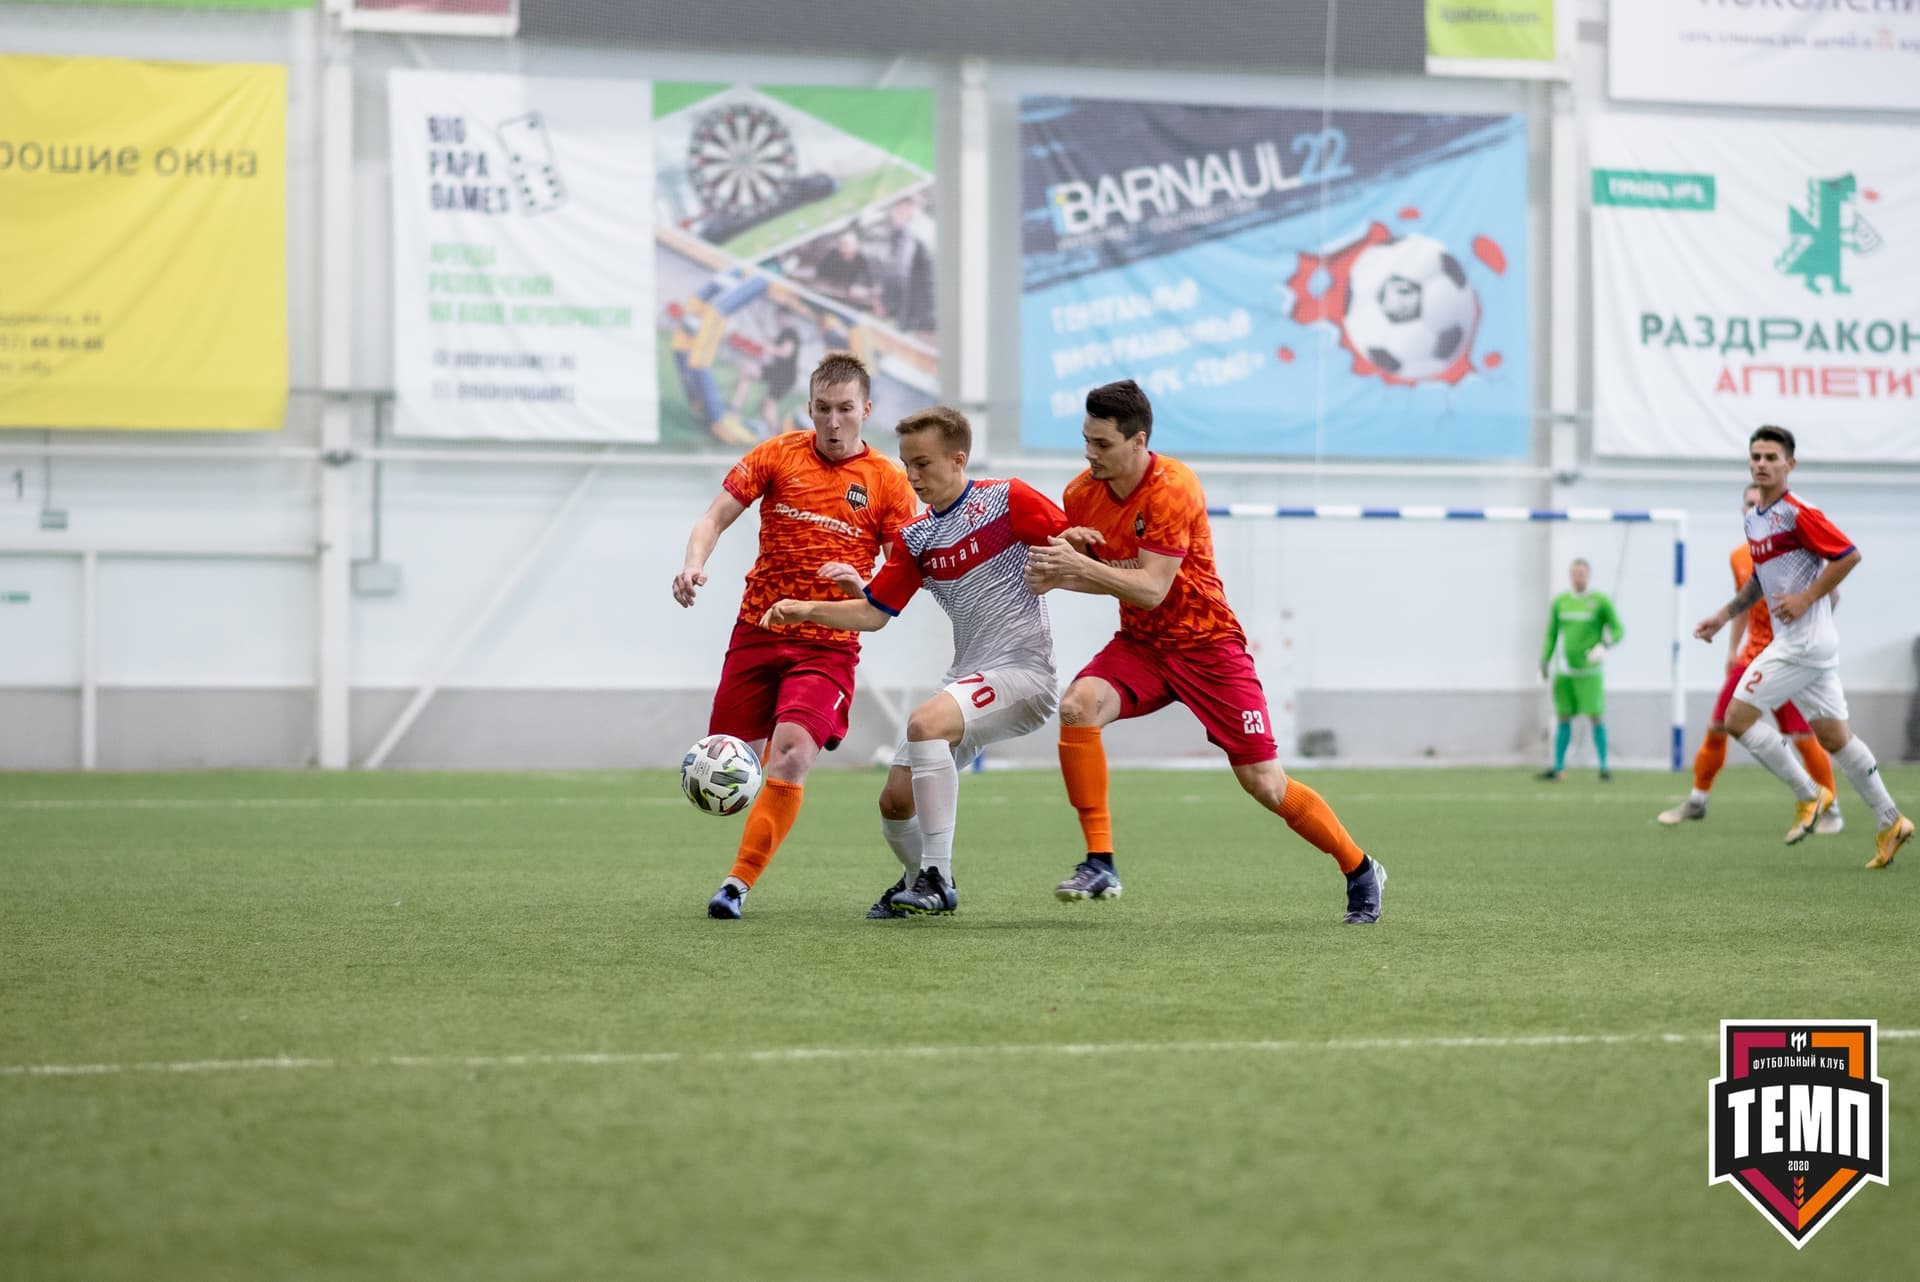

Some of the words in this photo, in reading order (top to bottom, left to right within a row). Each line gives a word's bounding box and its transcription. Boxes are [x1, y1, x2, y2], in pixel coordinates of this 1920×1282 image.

[154, 146, 258, 178] окна
[1744, 671, 1762, 694] 2
[833, 690, 845, 711] 7
[1241, 710, 1265, 735] 23
